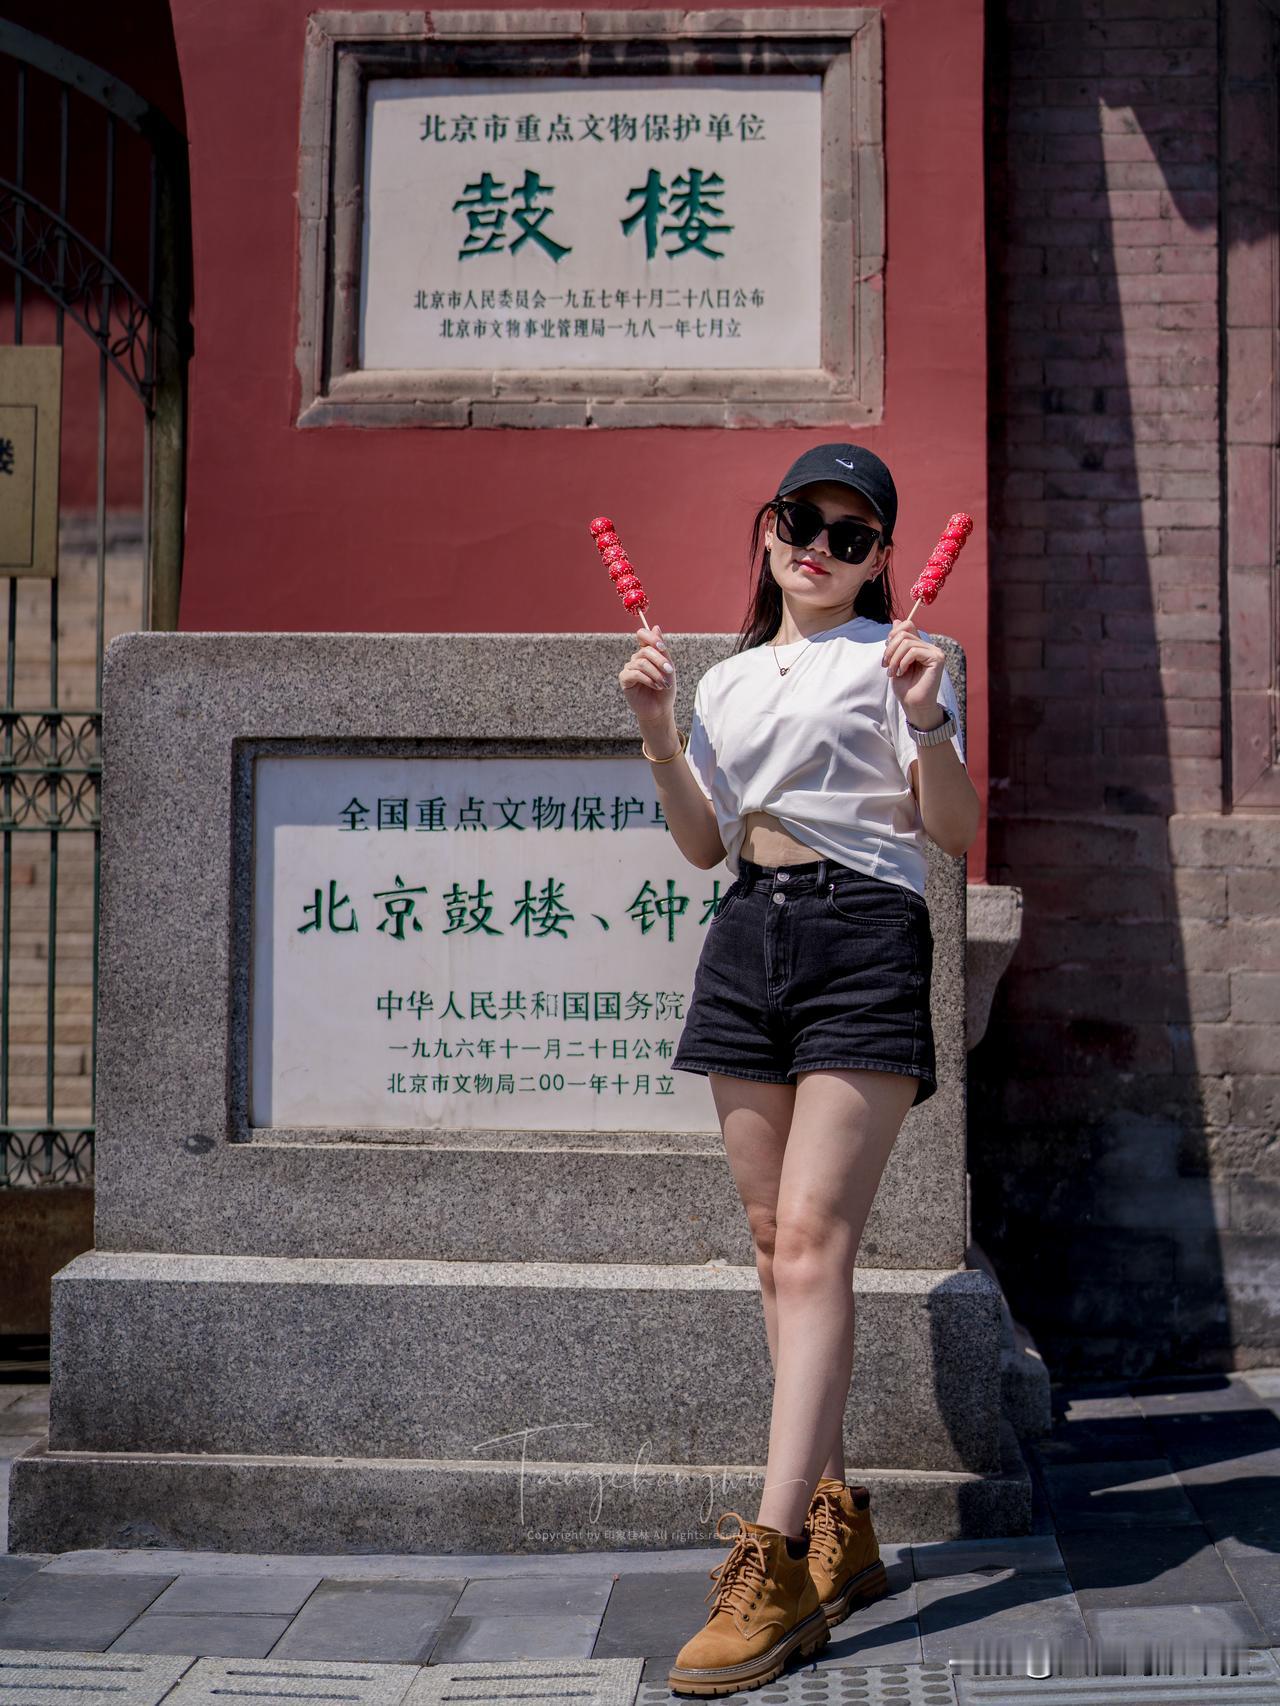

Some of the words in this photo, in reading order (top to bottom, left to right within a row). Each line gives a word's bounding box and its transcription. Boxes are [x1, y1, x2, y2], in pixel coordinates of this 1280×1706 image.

[419, 113, 767, 143] 北京市重点文物保护单位
[451, 167, 735, 263] 鼓楼
[413, 288, 766, 310] 北京市人民委员会一九五七年十月二十八日公布
[439, 318, 743, 339] 北京市文物事业管理局一九八一年七月立
[376, 989, 685, 1021] 中华人民共和国国务院
[388, 1037, 675, 1060] 一九九六年十一月二十日公布
